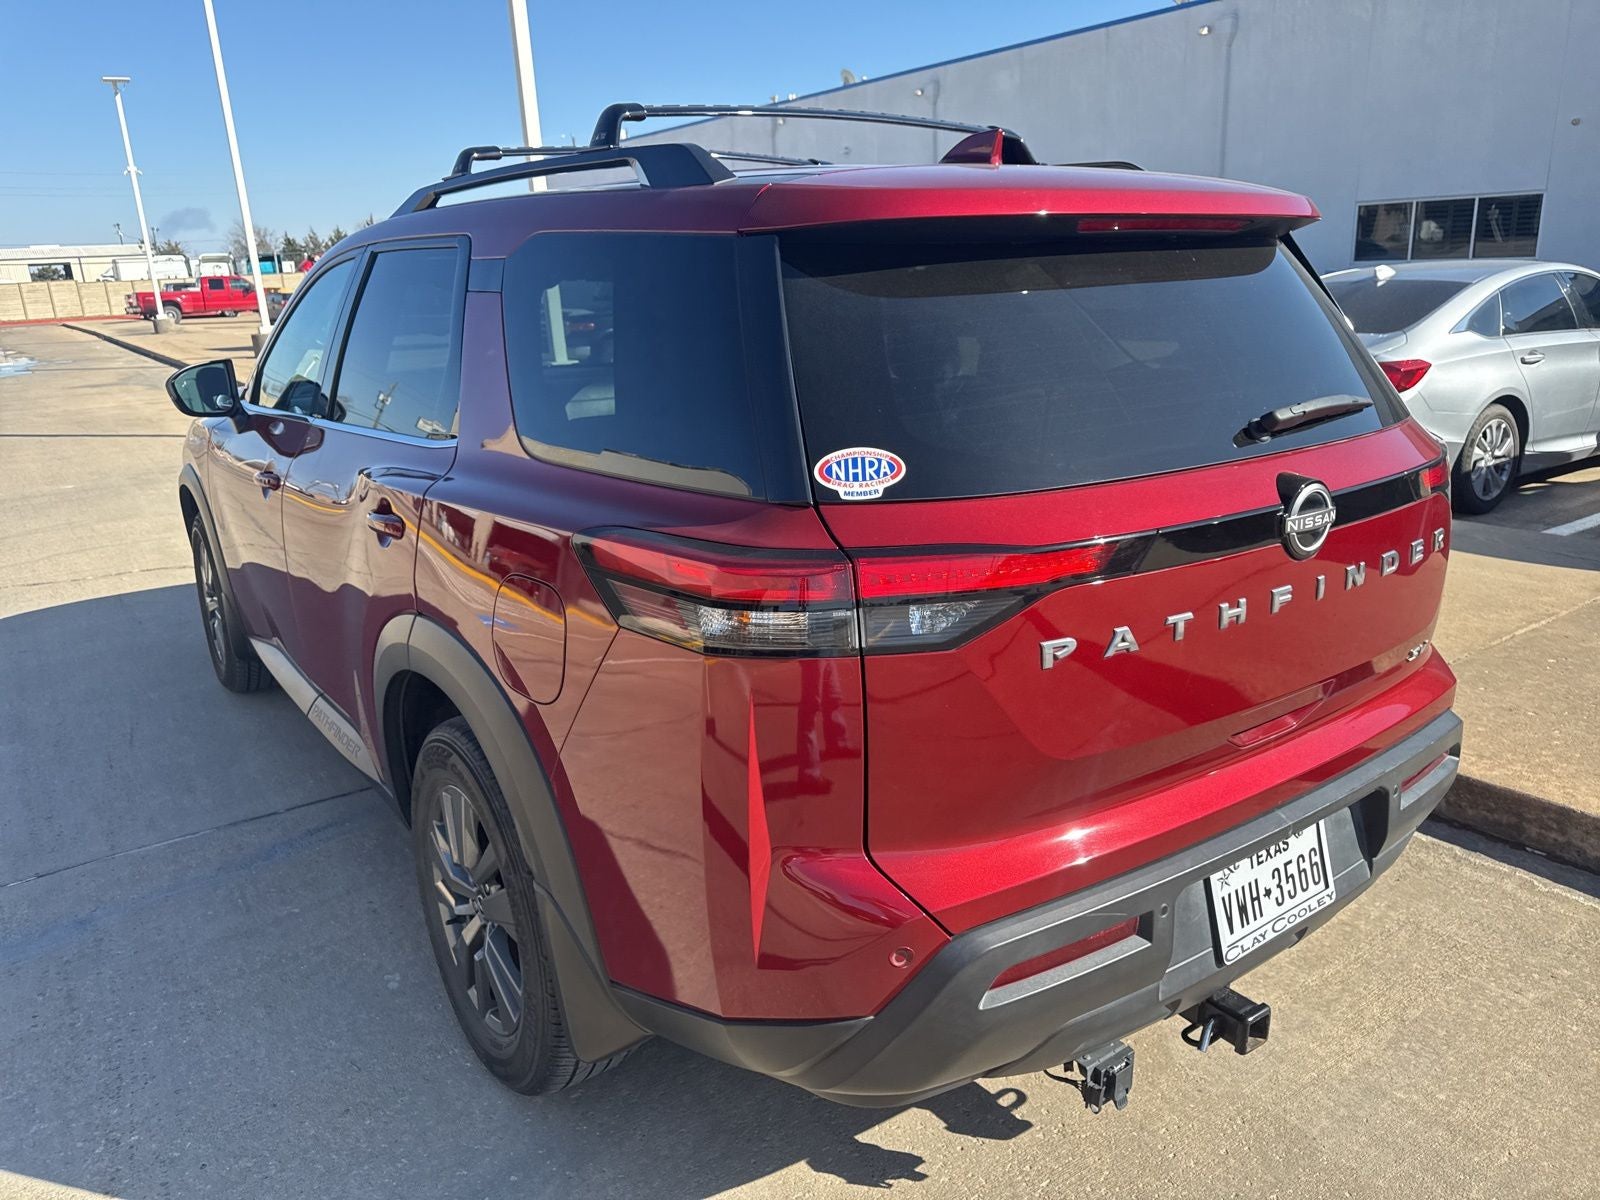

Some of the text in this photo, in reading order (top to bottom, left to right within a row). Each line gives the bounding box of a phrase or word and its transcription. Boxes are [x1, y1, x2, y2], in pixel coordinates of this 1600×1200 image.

[830, 450, 890, 462] CHAMPIONSHIP
[831, 457, 892, 482] NHRA
[831, 478, 891, 488] DRAG RACING
[843, 488, 880, 497] MEMBER
[1287, 509, 1336, 532] NISSAN
[1040, 527, 1446, 670] PATHFINDER
[311, 705, 361, 759] PATHFINDER
[1249, 840, 1289, 869] TEXAS
[1224, 891, 1335, 962] CLAY COOLEY
